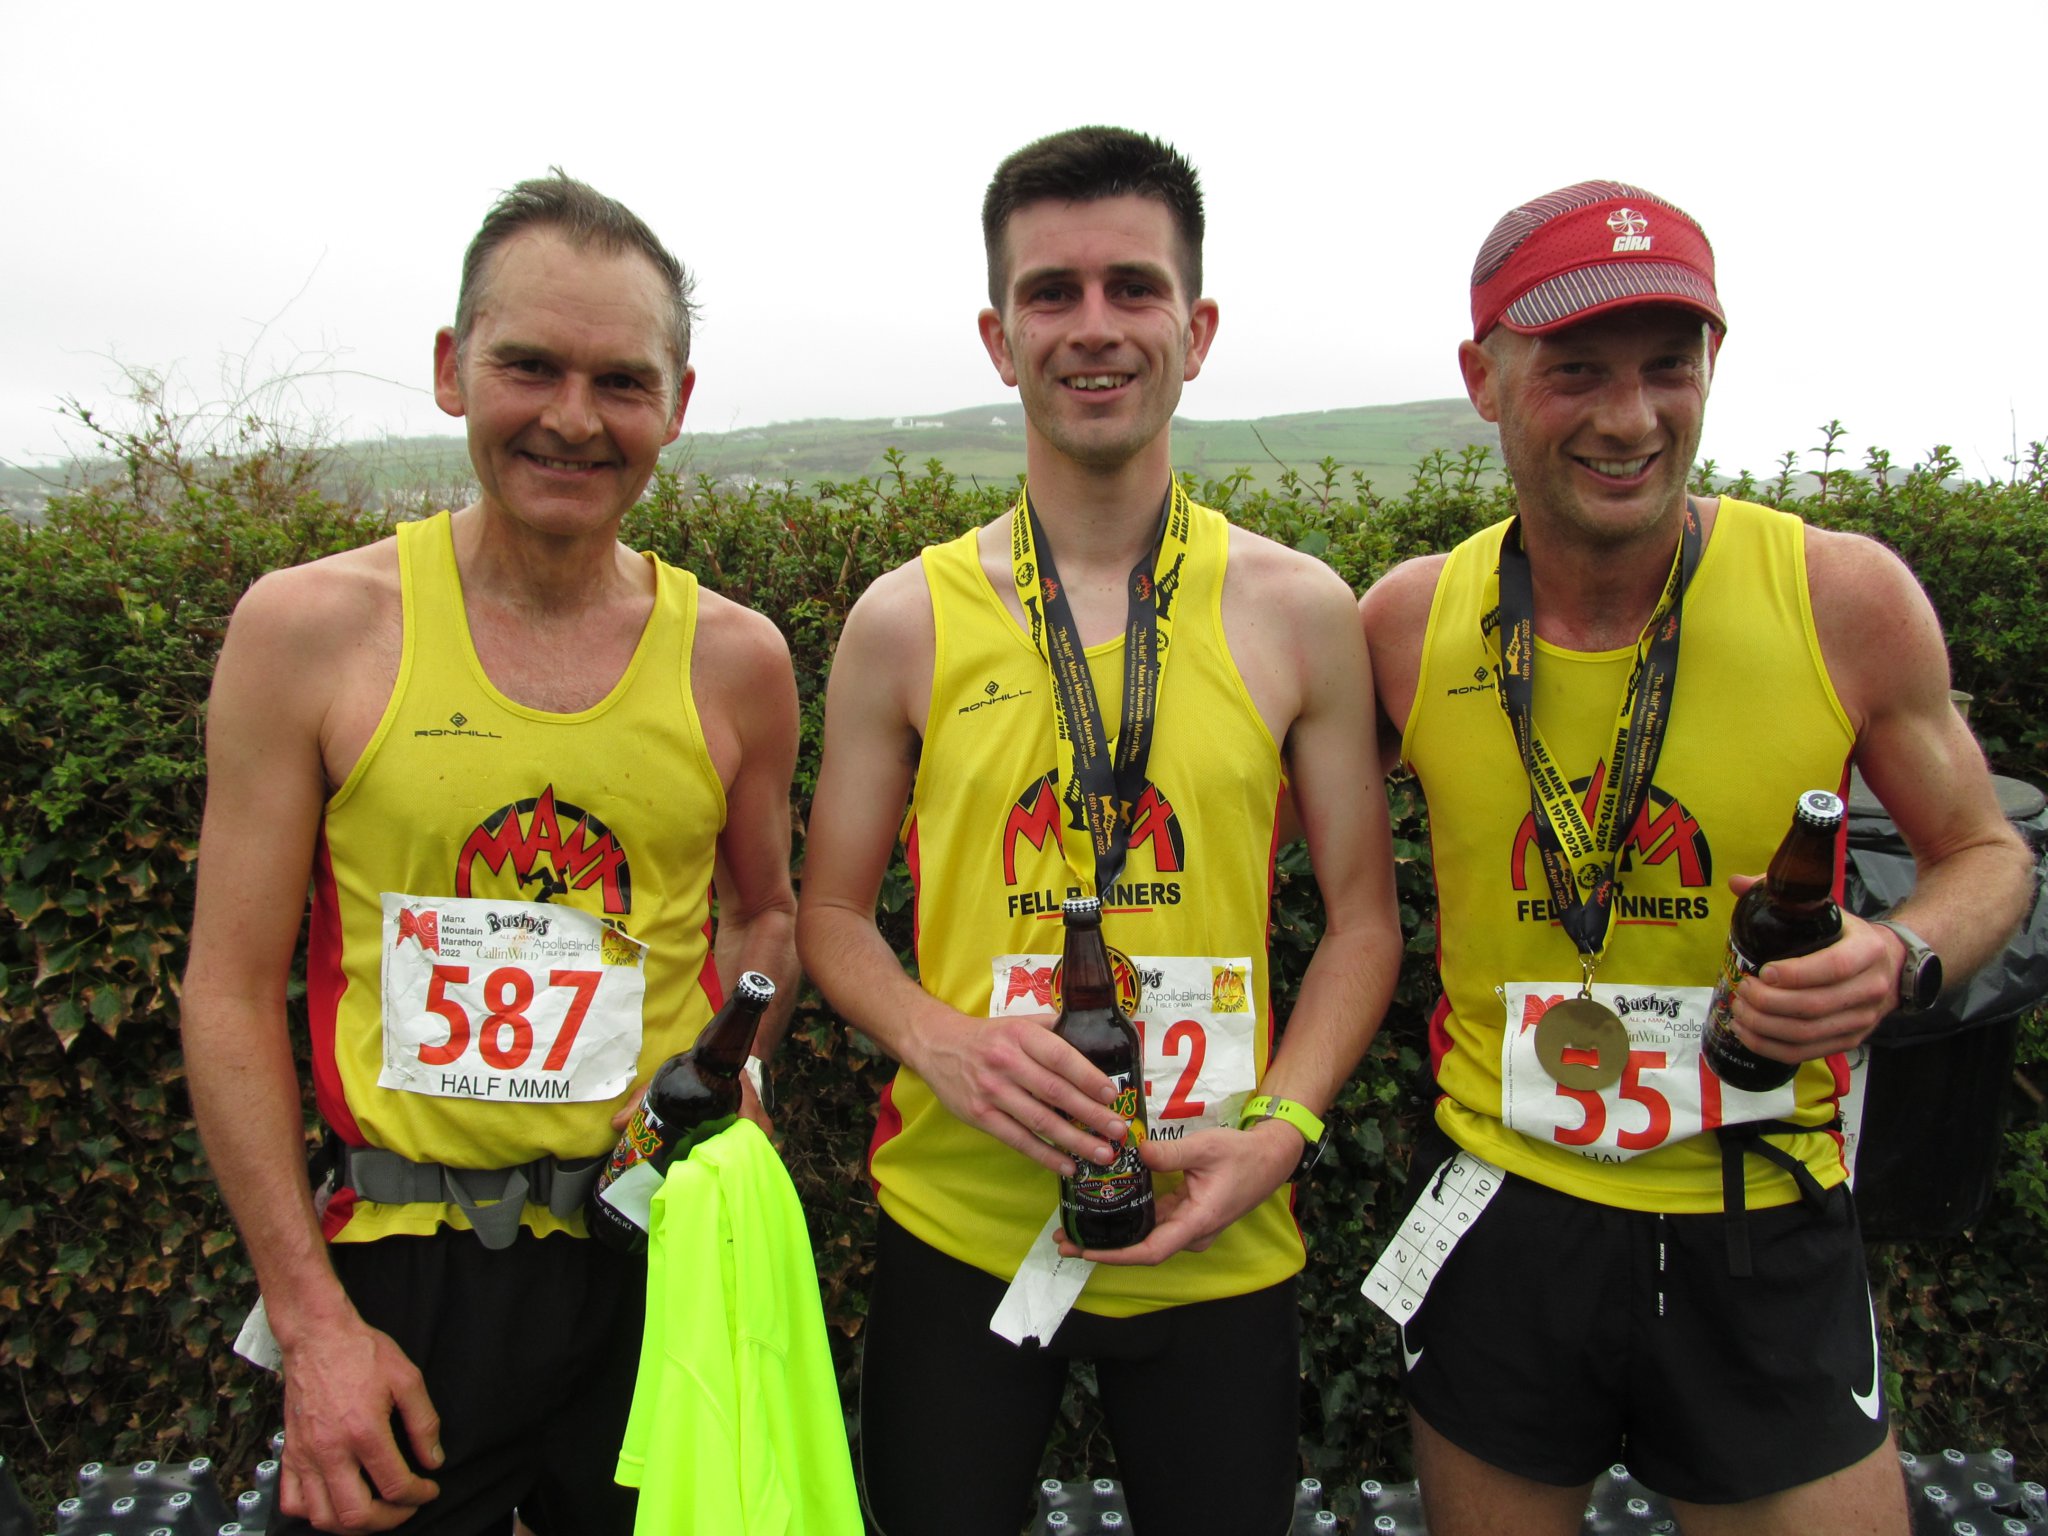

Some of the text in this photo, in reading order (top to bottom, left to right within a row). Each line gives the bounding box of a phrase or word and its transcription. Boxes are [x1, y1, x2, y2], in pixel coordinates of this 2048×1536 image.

[1612, 235, 1652, 252] GIRA
[1170, 514, 1180, 538] HALF
[1522, 619, 1530, 641] 2022
[1522, 644, 1532, 665] April
[1068, 661, 1080, 683] Manx
[1138, 664, 1146, 686] Manx
[959, 690, 1032, 716] RONHILL
[1073, 683, 1090, 719] Mountain
[1137, 687, 1146, 722] Mountain
[1643, 710, 1656, 735] Manx
[415, 730, 502, 739] RONHILL
[1082, 718, 1096, 758] Marathon
[1129, 723, 1144, 762] Marathon
[1608, 727, 1629, 788] MARATHON
[1636, 735, 1650, 774] Mountain
[1531, 740, 1549, 757] HALF
[1544, 761, 1569, 799] MANX
[1562, 799, 1595, 854] MOUNTAIN
[1628, 775, 1642, 815] Marathon
[1087, 792, 1106, 856] 16th April 2022
[1550, 803, 1583, 859] 1970-2020
[1596, 793, 1616, 852] 1970-2020
[1548, 869, 1561, 889] April
[1008, 882, 1182, 918] FELL RNNERS
[1614, 896, 1710, 921] NNERS
[442, 914, 465, 923] Manx
[485, 911, 553, 936] Bushy's
[441, 926, 483, 936] Mountain
[441, 937, 483, 947] Marathon
[440, 948, 461, 957] 2022
[533, 937, 600, 954] ApolloBlinds
[1147, 987, 1212, 1006] ApolloBlinds
[1614, 993, 1682, 1019] Bushy's
[417, 963, 603, 1072] 587
[441, 1073, 570, 1099] HALF MMM
[1452, 1163, 1465, 1177] 5
[1474, 1179, 1491, 1198] 10
[1413, 1221, 1425, 1234] 3
[1395, 1249, 1407, 1263] 2
[1436, 1239, 1448, 1251] 8
[1417, 1268, 1428, 1281] 7
[1377, 1281, 1388, 1292] 1
